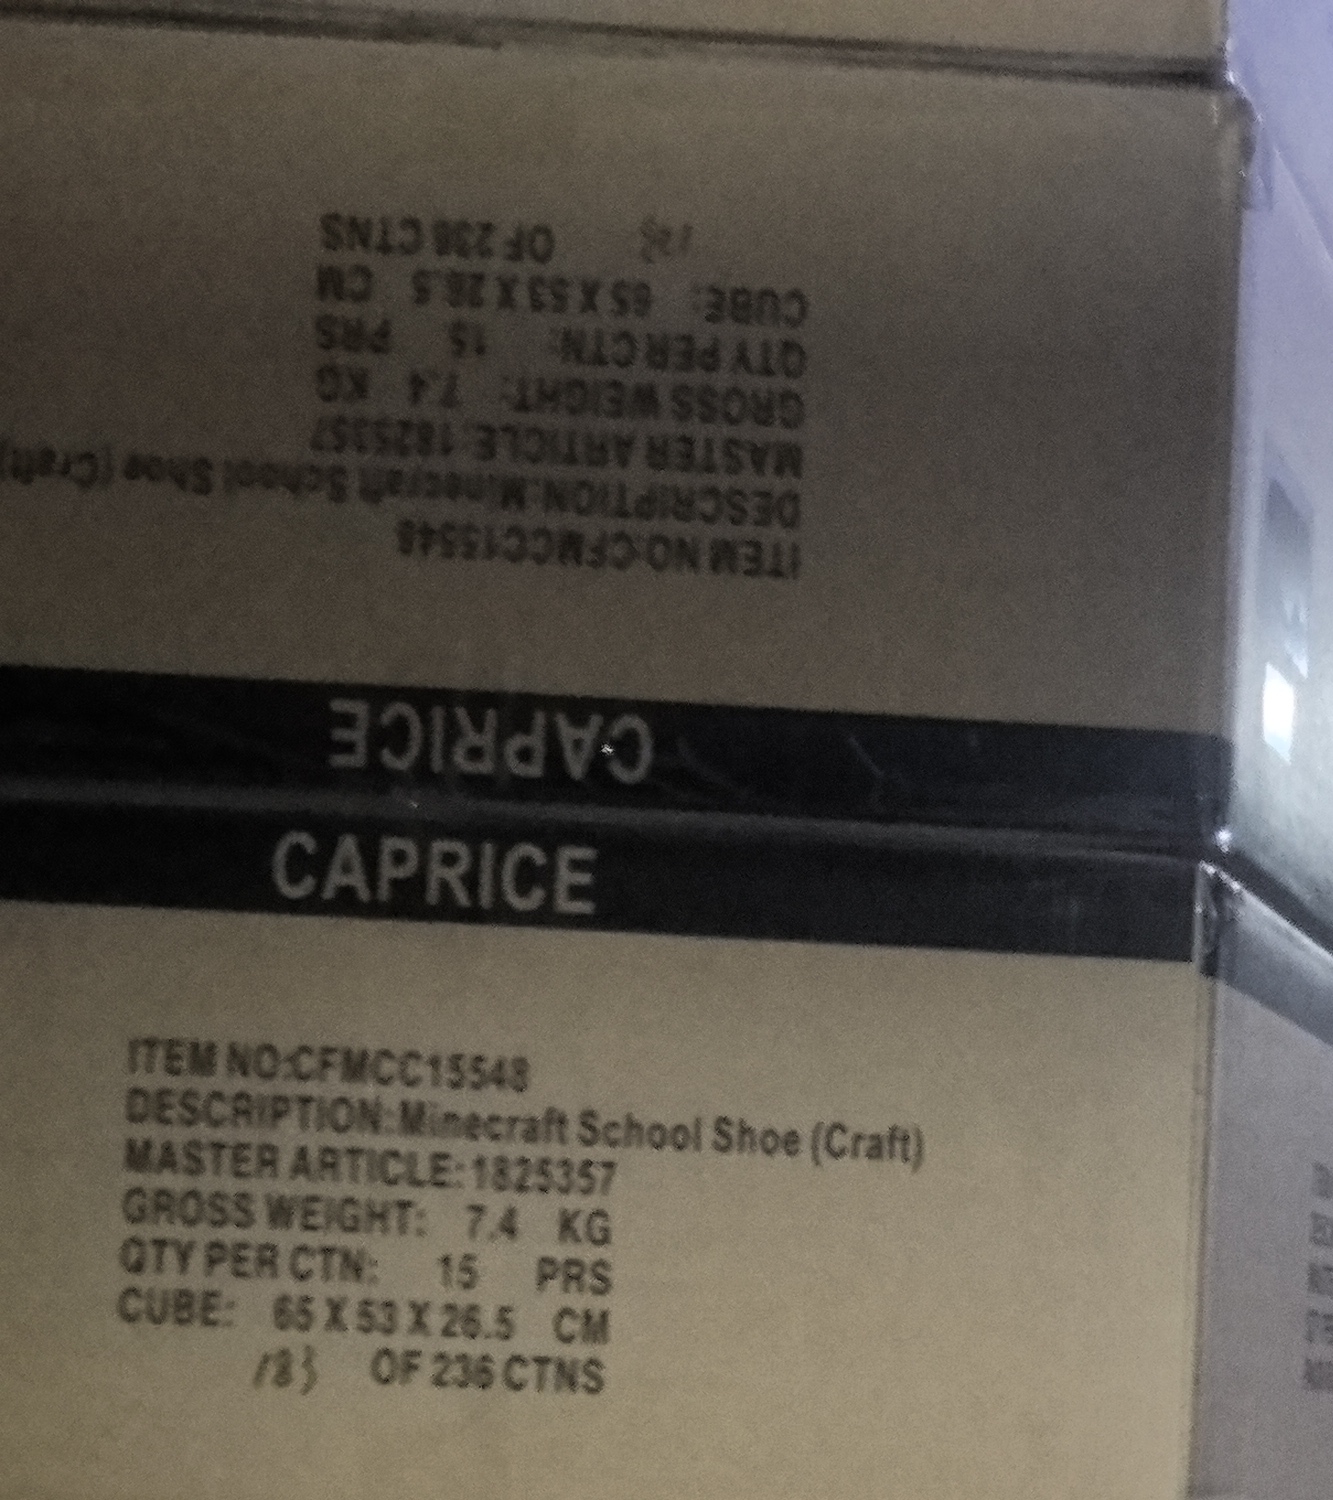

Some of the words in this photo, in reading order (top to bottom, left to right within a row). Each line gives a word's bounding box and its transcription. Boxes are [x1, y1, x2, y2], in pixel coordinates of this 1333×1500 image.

[321, 213, 422, 254] CTNS
[506, 225, 553, 263] OF
[315, 265, 372, 302] CM
[497, 276, 516, 308] X
[528, 276, 569, 311] 53
[581, 280, 599, 311] X
[611, 281, 650, 315] 65
[314, 314, 390, 353] PRS
[450, 321, 485, 356] 15
[646, 335, 719, 371] PER
[733, 339, 806, 377] QTY
[315, 362, 368, 402] KG
[409, 373, 455, 406] 7.4
[672, 386, 803, 427] GROSS
[121, 453, 214, 495] Shoe
[648, 437, 802, 476] MASTER
[223, 460, 347, 502] School
[709, 539, 800, 578] ITEM
[329, 698, 654, 785] CAPRICE
[272, 830, 598, 914] CAPRICE
[128, 1036, 217, 1076] ITEM
[124, 1139, 277, 1176] MASTER
[577, 1109, 701, 1150] School
[712, 1116, 801, 1156] Shoe
[810, 1122, 923, 1168] (Craft)
[122, 1187, 252, 1226] GROSS
[268, 1196, 426, 1232] WEIGHT:
[468, 1204, 517, 1238] 7.4
[558, 1209, 610, 1246] KG
[119, 1236, 193, 1274] QTY
[206, 1241, 277, 1277] PER
[290, 1245, 378, 1280] CTN:
[440, 1254, 476, 1289] 15
[536, 1257, 612, 1295] PRS
[116, 1287, 234, 1326] CUBE:
[273, 1295, 313, 1331] 65
[325, 1298, 346, 1331] X
[357, 1299, 396, 1335] 53
[409, 1301, 429, 1335] X
[441, 1303, 513, 1340] 26.5
[553, 1307, 609, 1344] CM
[370, 1347, 421, 1385] OF
[431, 1352, 495, 1389] 236
[502, 1354, 604, 1394] CTNS
